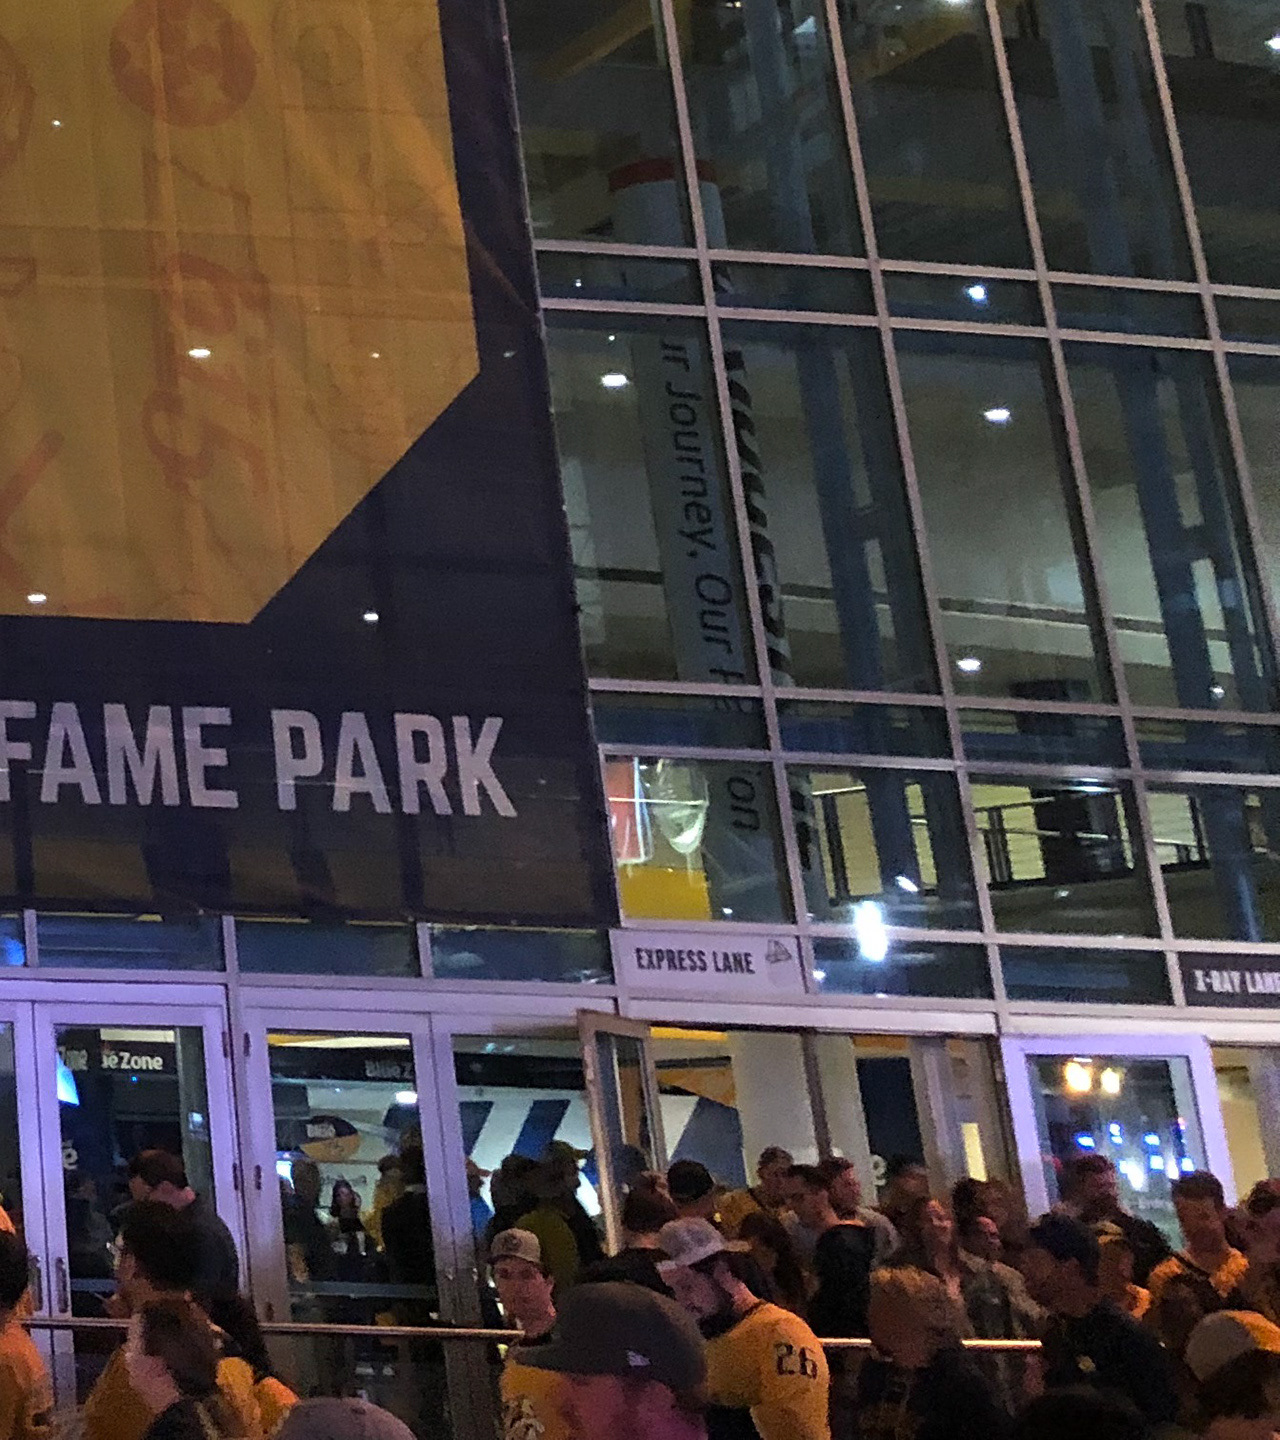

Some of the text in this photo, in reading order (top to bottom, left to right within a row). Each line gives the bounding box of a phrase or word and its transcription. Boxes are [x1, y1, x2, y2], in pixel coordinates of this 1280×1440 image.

[694, 573, 734, 655] Our
[271, 708, 518, 819] PARK
[635, 947, 756, 975] EXPRESS LANE
[1193, 968, 1241, 993] X-RAY
[118, 1051, 164, 1071] Zone
